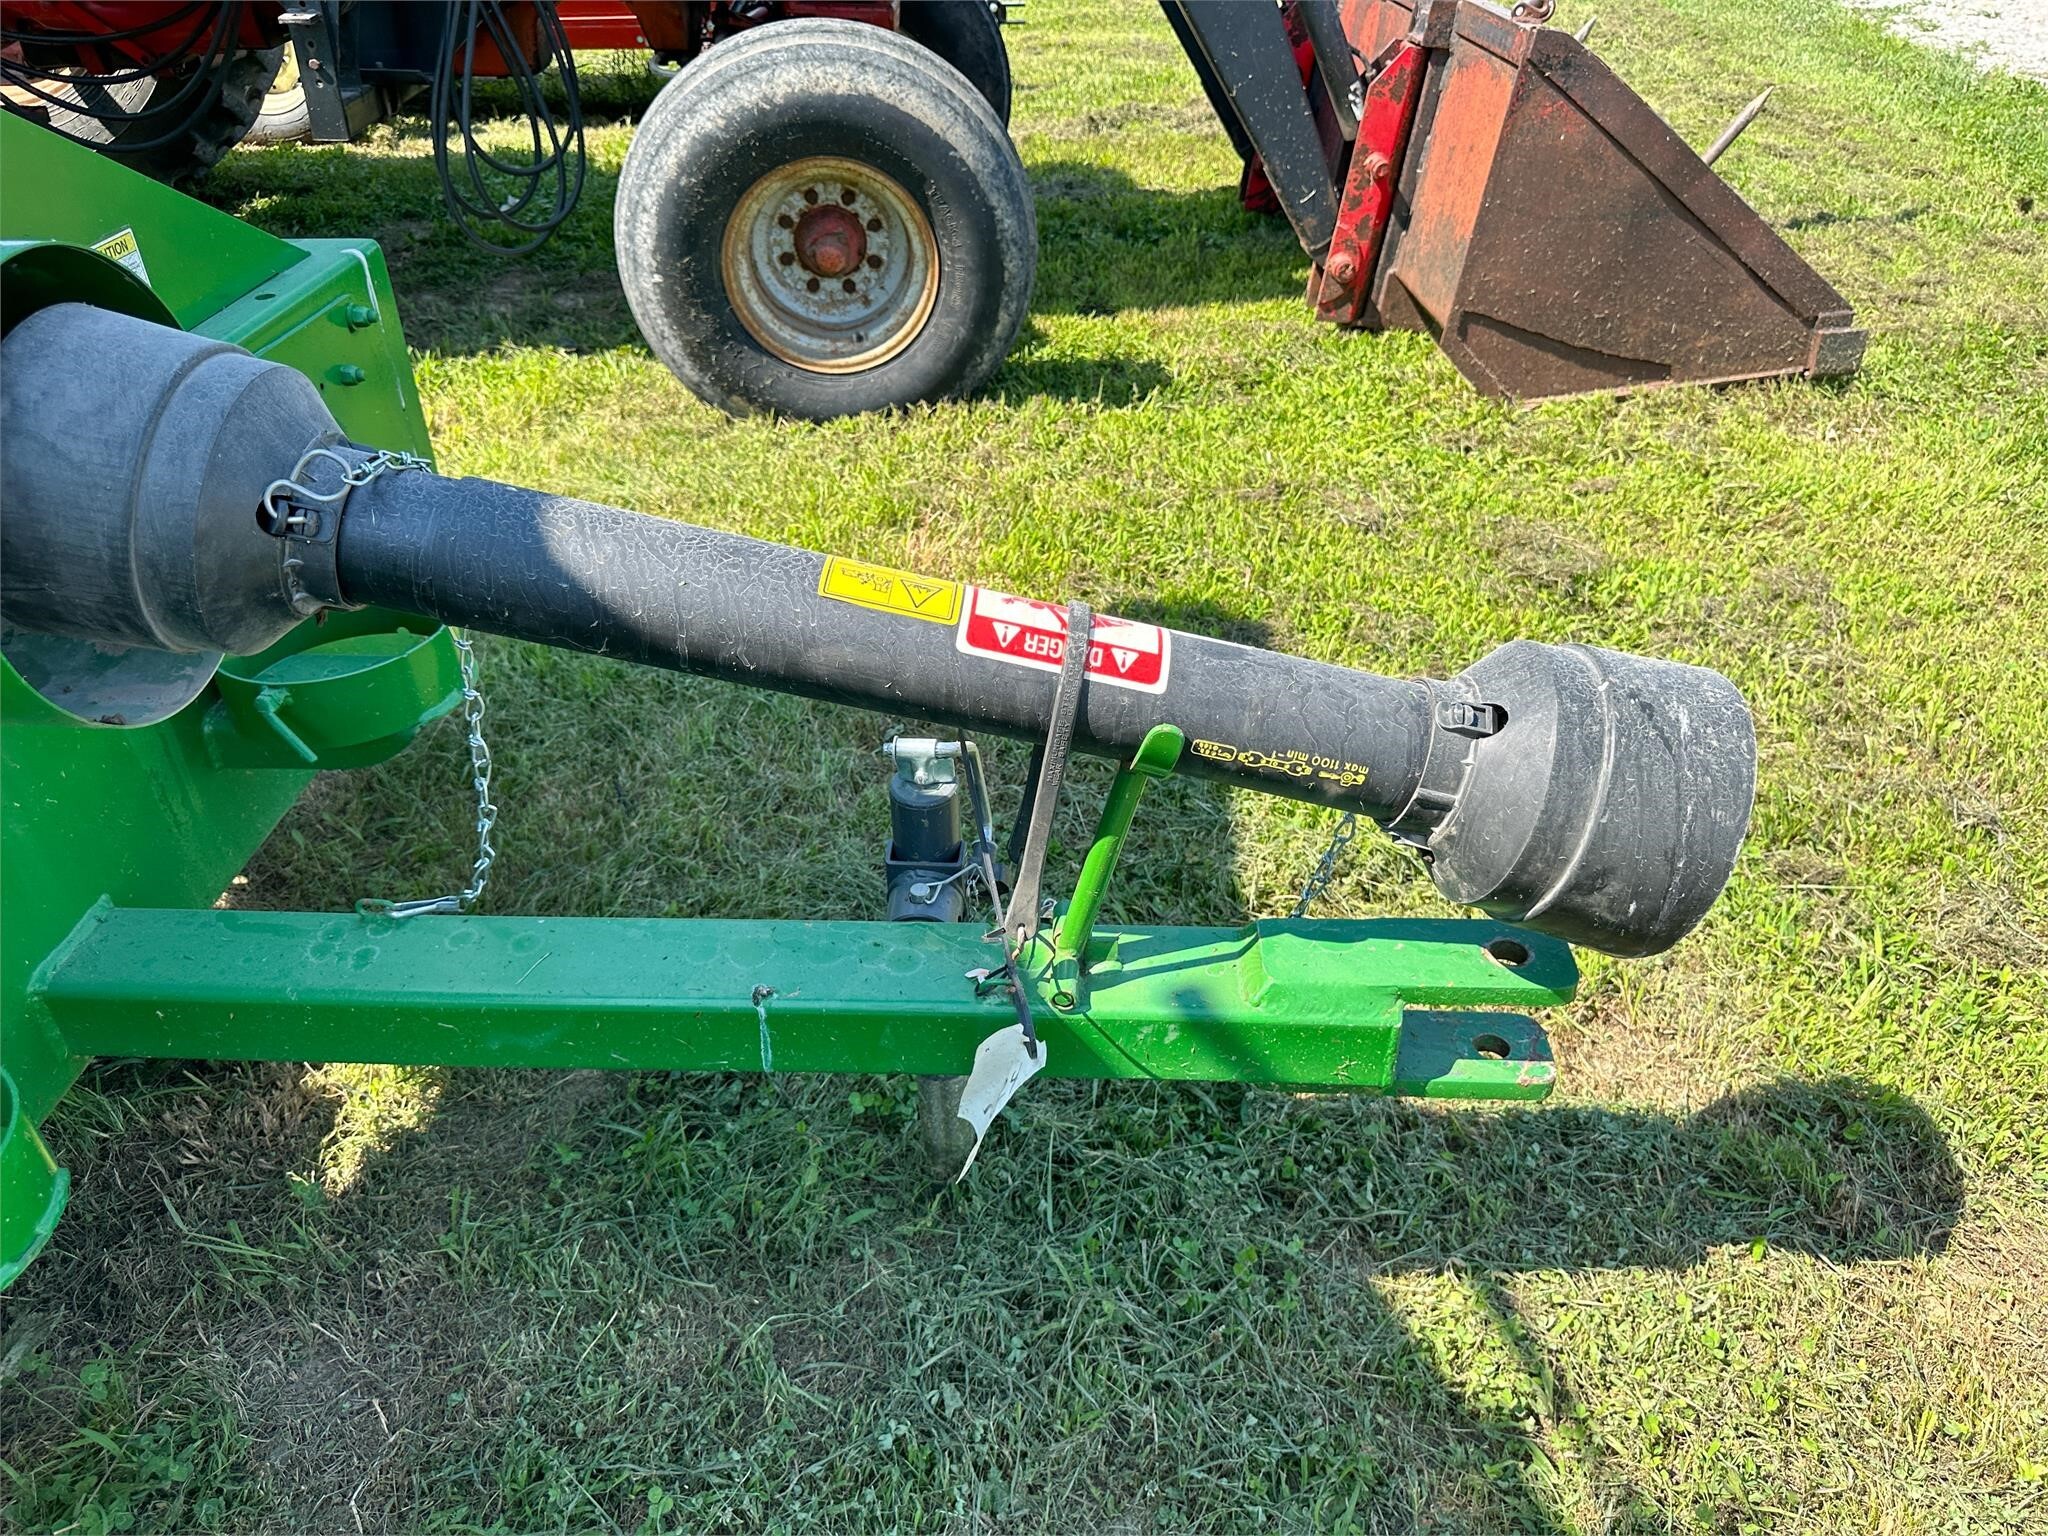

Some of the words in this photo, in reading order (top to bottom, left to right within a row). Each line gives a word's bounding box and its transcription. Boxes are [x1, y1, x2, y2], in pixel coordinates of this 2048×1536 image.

[1024, 631, 1104, 668] DGER
[1311, 755, 1340, 770] 1100
[1343, 762, 1369, 775] max
